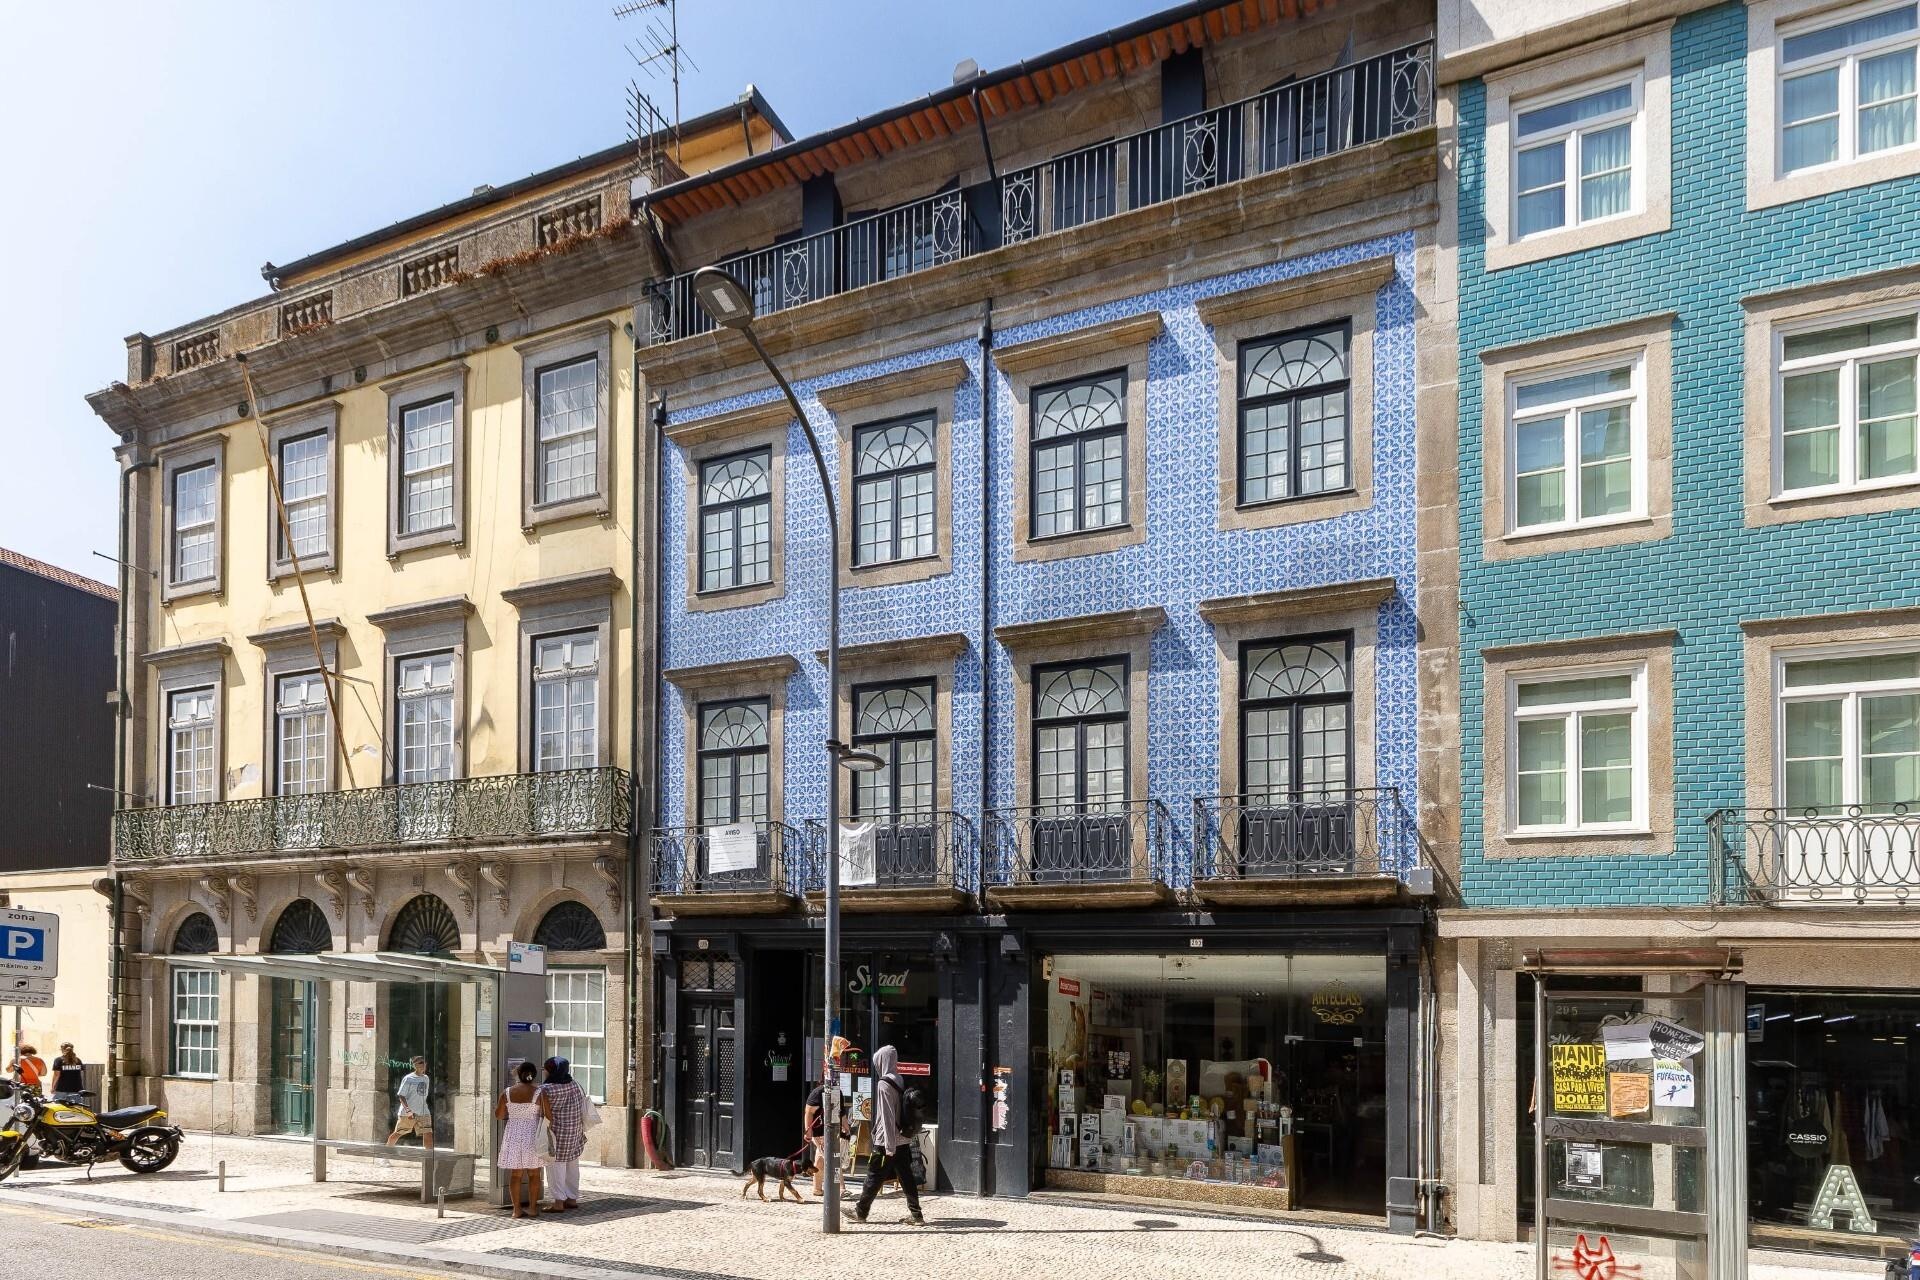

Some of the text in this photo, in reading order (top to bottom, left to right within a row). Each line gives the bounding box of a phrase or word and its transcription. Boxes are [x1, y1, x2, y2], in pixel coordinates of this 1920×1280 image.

[8, 912, 35, 922] zona
[8, 929, 35, 956] P
[1653, 1021, 1692, 1042] HOMENS
[1553, 1045, 1603, 1066] MANIF
[1556, 1081, 1571, 1092] CASA
[1571, 1081, 1587, 1093] PARA
[1556, 1094, 1589, 1105] DOM
[1789, 1133, 1827, 1142] CASSIO
[1809, 1164, 1877, 1233] A
